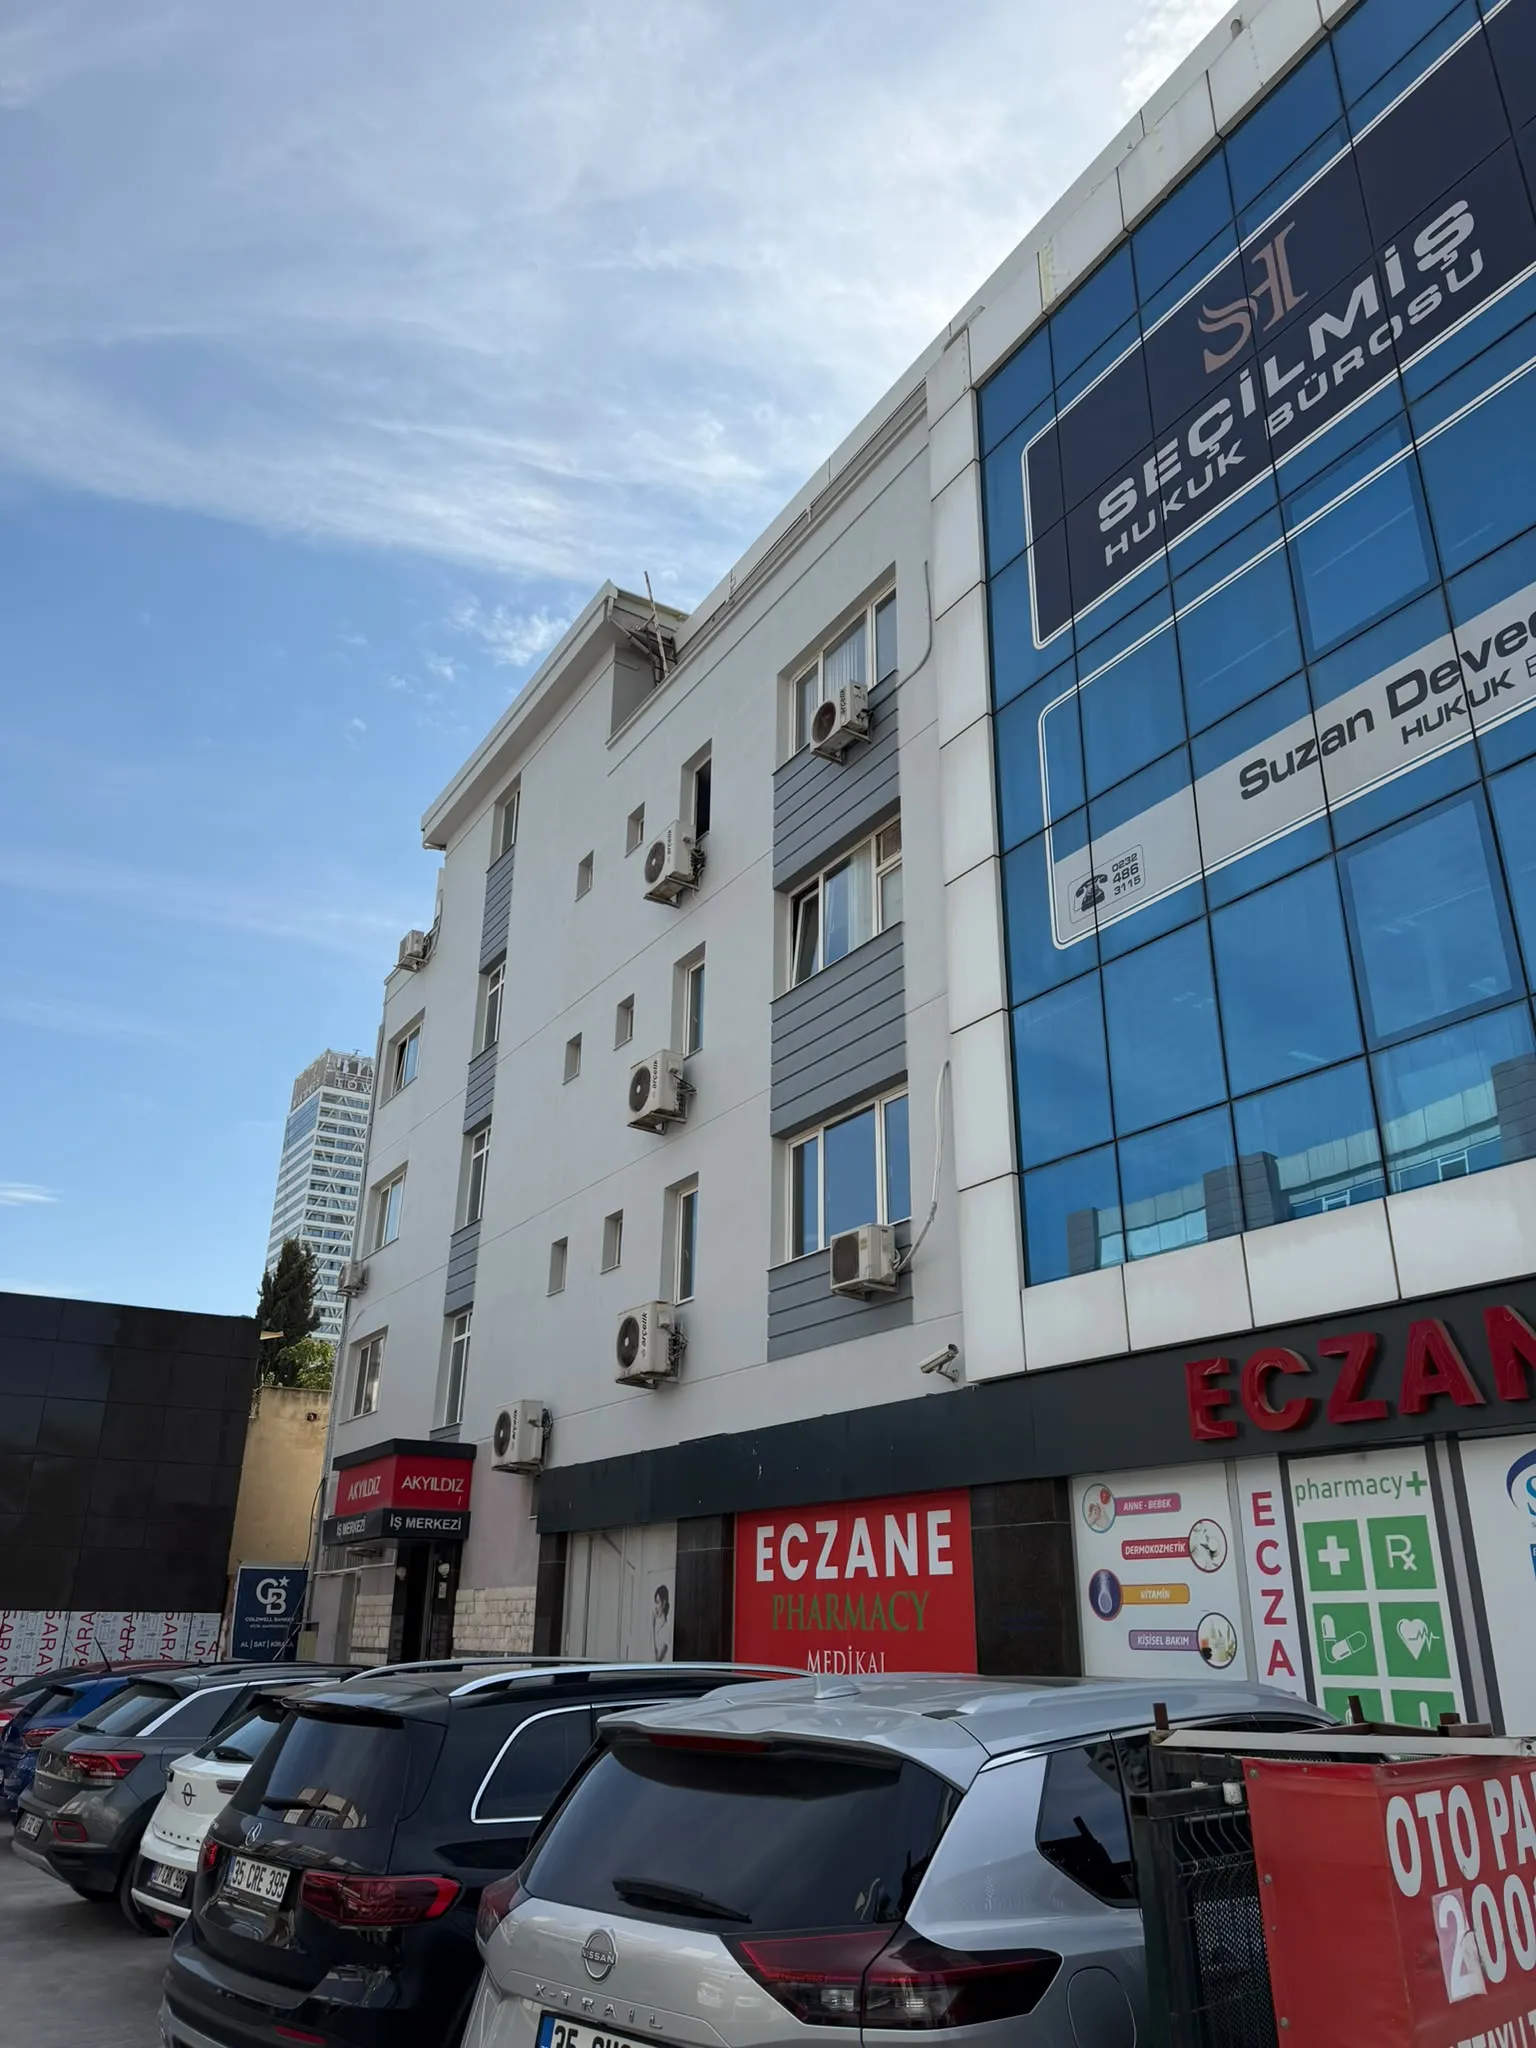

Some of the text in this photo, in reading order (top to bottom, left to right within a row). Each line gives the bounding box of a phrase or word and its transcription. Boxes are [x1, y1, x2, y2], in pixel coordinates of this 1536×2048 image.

[1098, 200, 1475, 533] SEÇİLMİŞ
[1104, 248, 1484, 567] HUKUK BÜROSU
[1239, 610, 1536, 800] Suzan Deve
[1401, 668, 1516, 746] HUKUK
[1111, 852, 1139, 873] 0232
[1112, 862, 1140, 884] 486
[1113, 875, 1142, 896] 3115
[347, 1476, 382, 1502] AKYILDIZ
[401, 1475, 465, 1493] AKYILDIZ
[1123, 1500, 1144, 1512] ANNE
[1148, 1498, 1172, 1510] BEBEK
[389, 1513, 462, 1531] İŞ MERKEZİ
[756, 1509, 954, 1583] ECZANE
[1125, 1541, 1186, 1555] DERMOKOZMETİK
[1140, 1587, 1170, 1600] VİTAMİN
[771, 1590, 931, 1632] PHARMACY
[1137, 1633, 1190, 1648] KİŞİSEL BAKIM
[1386, 1770, 1536, 1898] OTO PA
[231, 1859, 288, 1899] 35 CRE 395
[1439, 1873, 1536, 2003] 200
[582, 1948, 616, 1964] NISSAN
[535, 1983, 664, 2030] X-TRAIL
